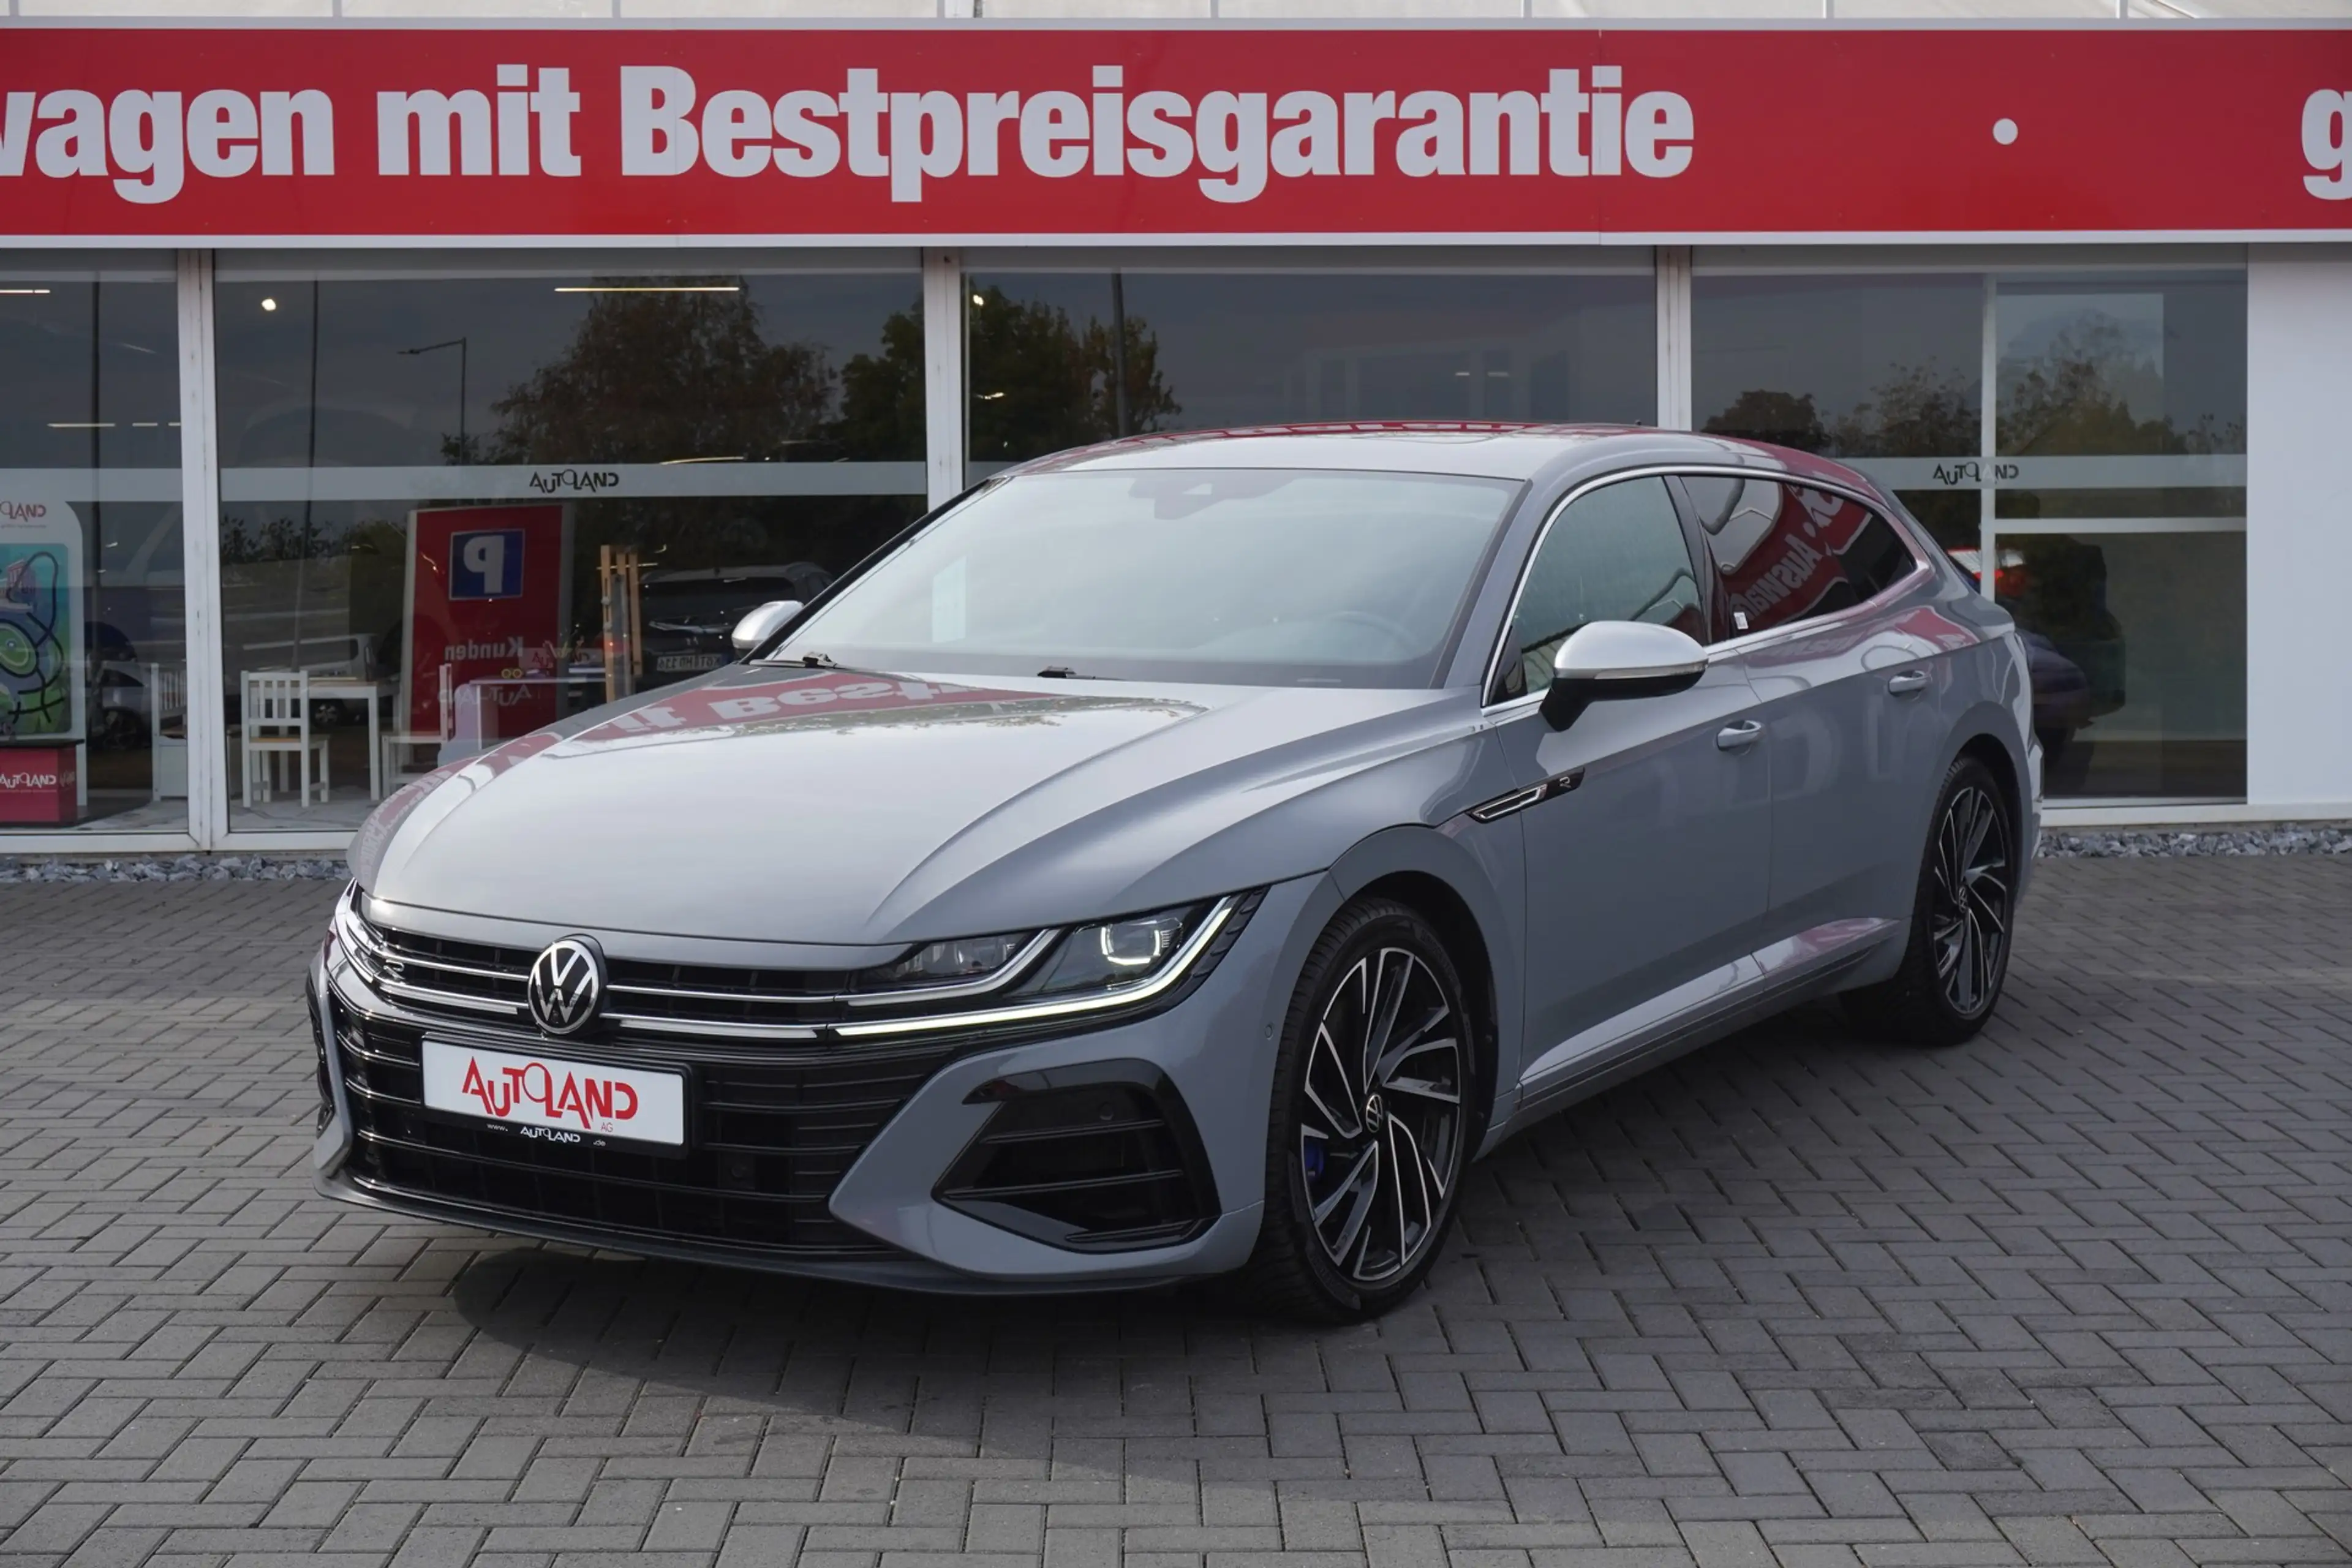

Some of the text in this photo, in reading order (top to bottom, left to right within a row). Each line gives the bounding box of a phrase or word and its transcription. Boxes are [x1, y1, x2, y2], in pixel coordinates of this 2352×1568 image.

[377, 64, 582, 178] mit
[620, 64, 1694, 203] Bestpreisgarantie
[529, 469, 619, 493] AUTOLAND
[462, 1056, 638, 1130] AUTOLAND
[520, 1126, 581, 1143] AUTOLAND
[600, 1121, 614, 1133] AG
